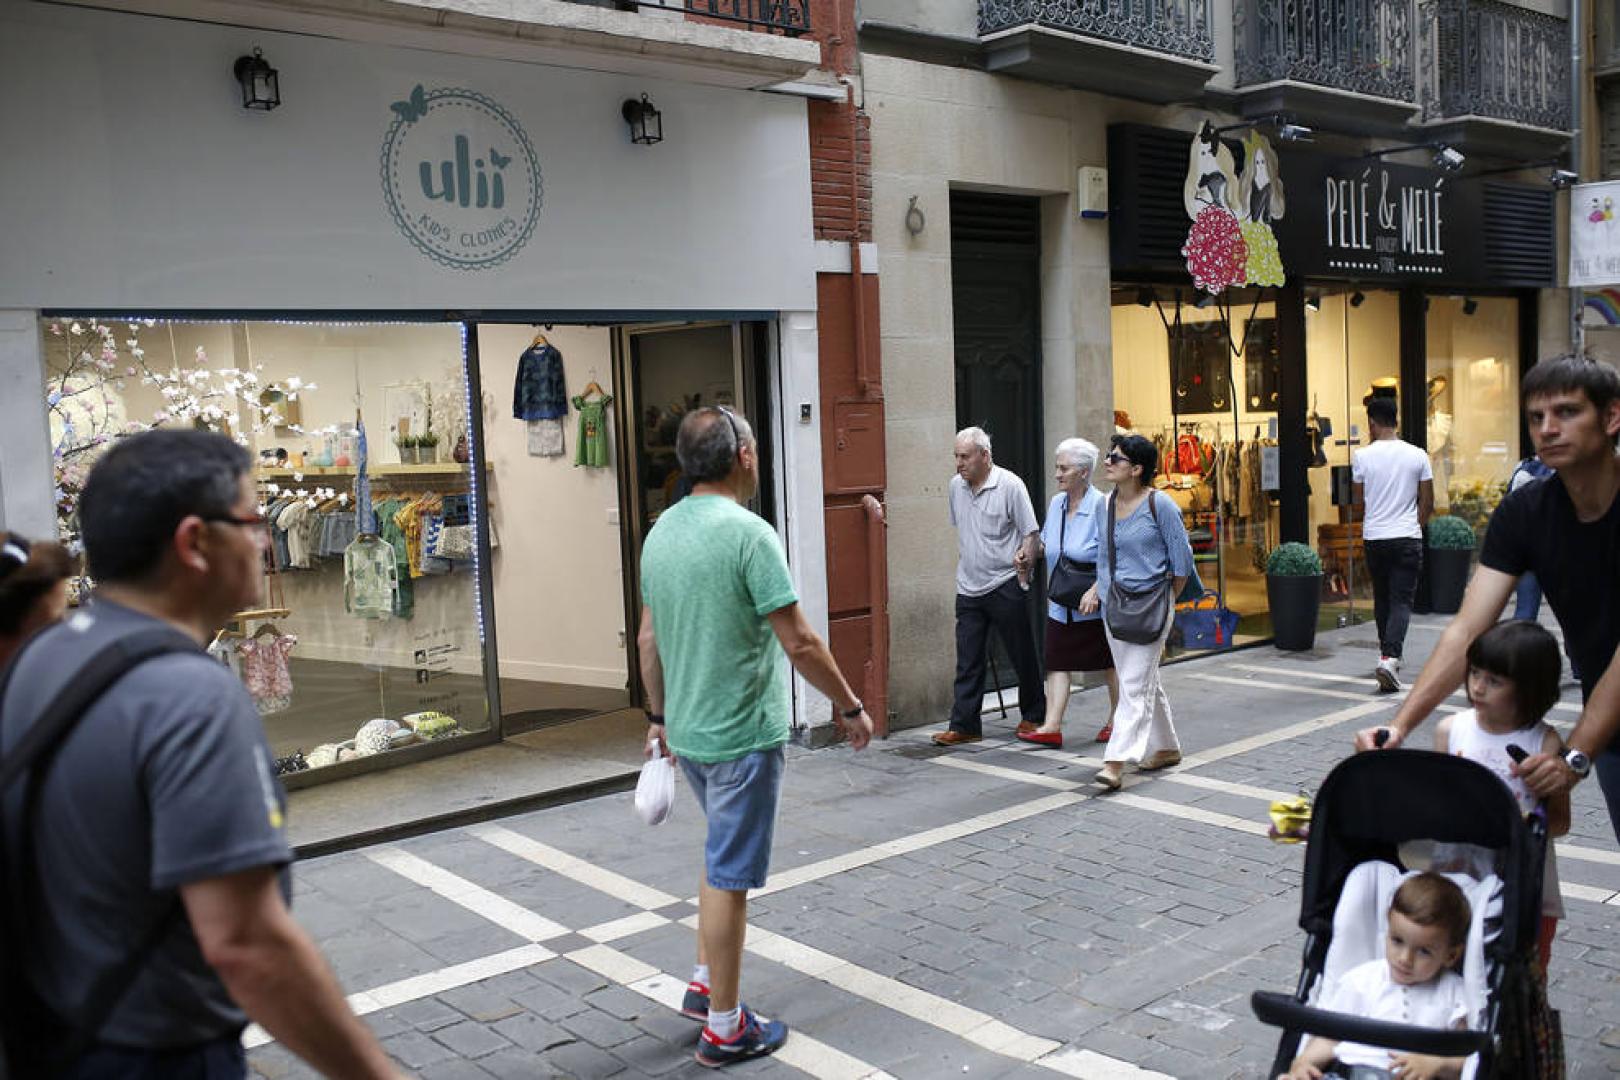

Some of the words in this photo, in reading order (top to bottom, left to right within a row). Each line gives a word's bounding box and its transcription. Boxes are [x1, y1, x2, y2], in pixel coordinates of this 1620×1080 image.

[419, 134, 510, 209] ulii
[419, 213, 451, 242] KIDS
[1326, 166, 1372, 250] PELÉ
[1378, 169, 1397, 230] &
[1401, 177, 1445, 256] MELÉ
